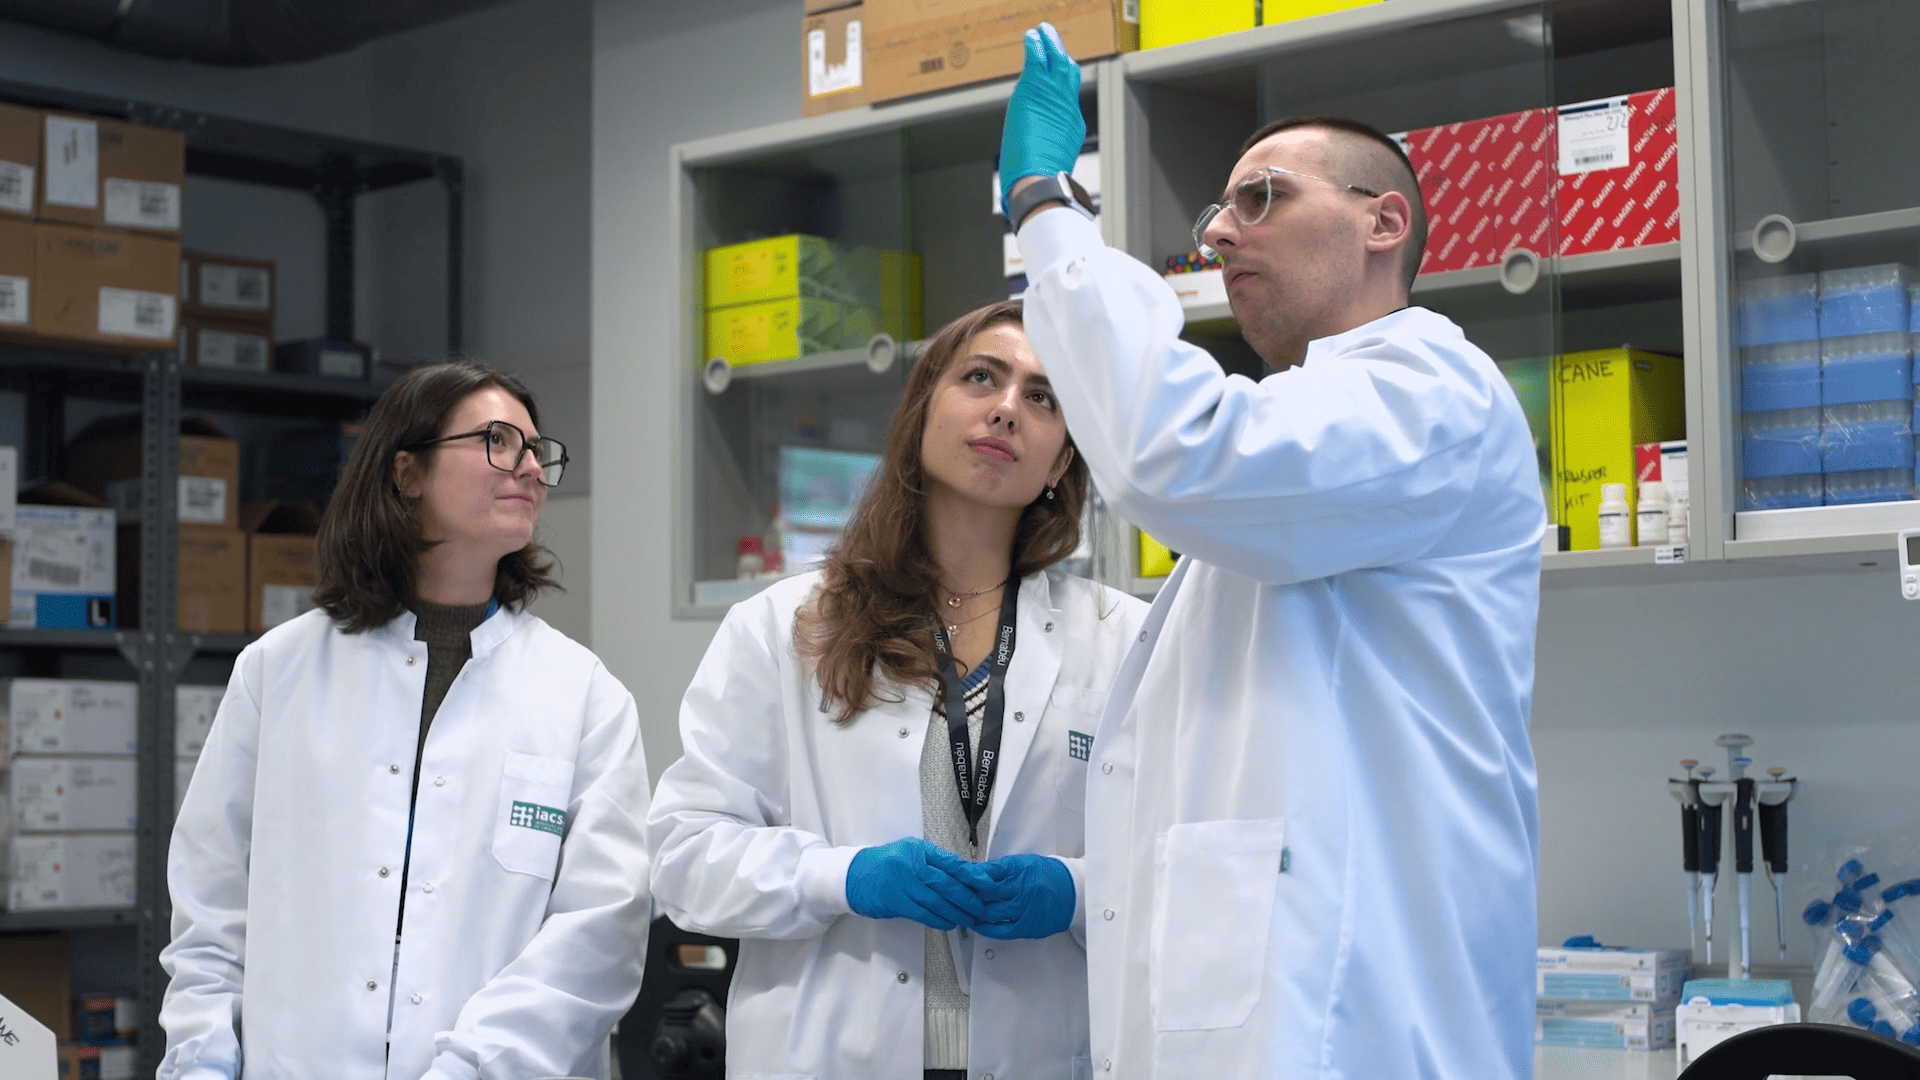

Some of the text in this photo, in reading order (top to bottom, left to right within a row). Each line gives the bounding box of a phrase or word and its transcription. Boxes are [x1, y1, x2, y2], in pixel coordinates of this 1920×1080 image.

[1634, 123, 1658, 153] QIAGEN
[1622, 161, 1646, 191] QIAGEN
[1592, 179, 1615, 209] QIAGEN
[1643, 180, 1667, 210] QIAGEN
[1561, 198, 1585, 227] QIAGEN
[1612, 198, 1636, 228] QIAGEN
[1581, 216, 1604, 246] QIAGEN
[997, 625, 1013, 667] Bernabéu
[977, 749, 995, 806] Bernabéu
[535, 806, 564, 825] iacs
